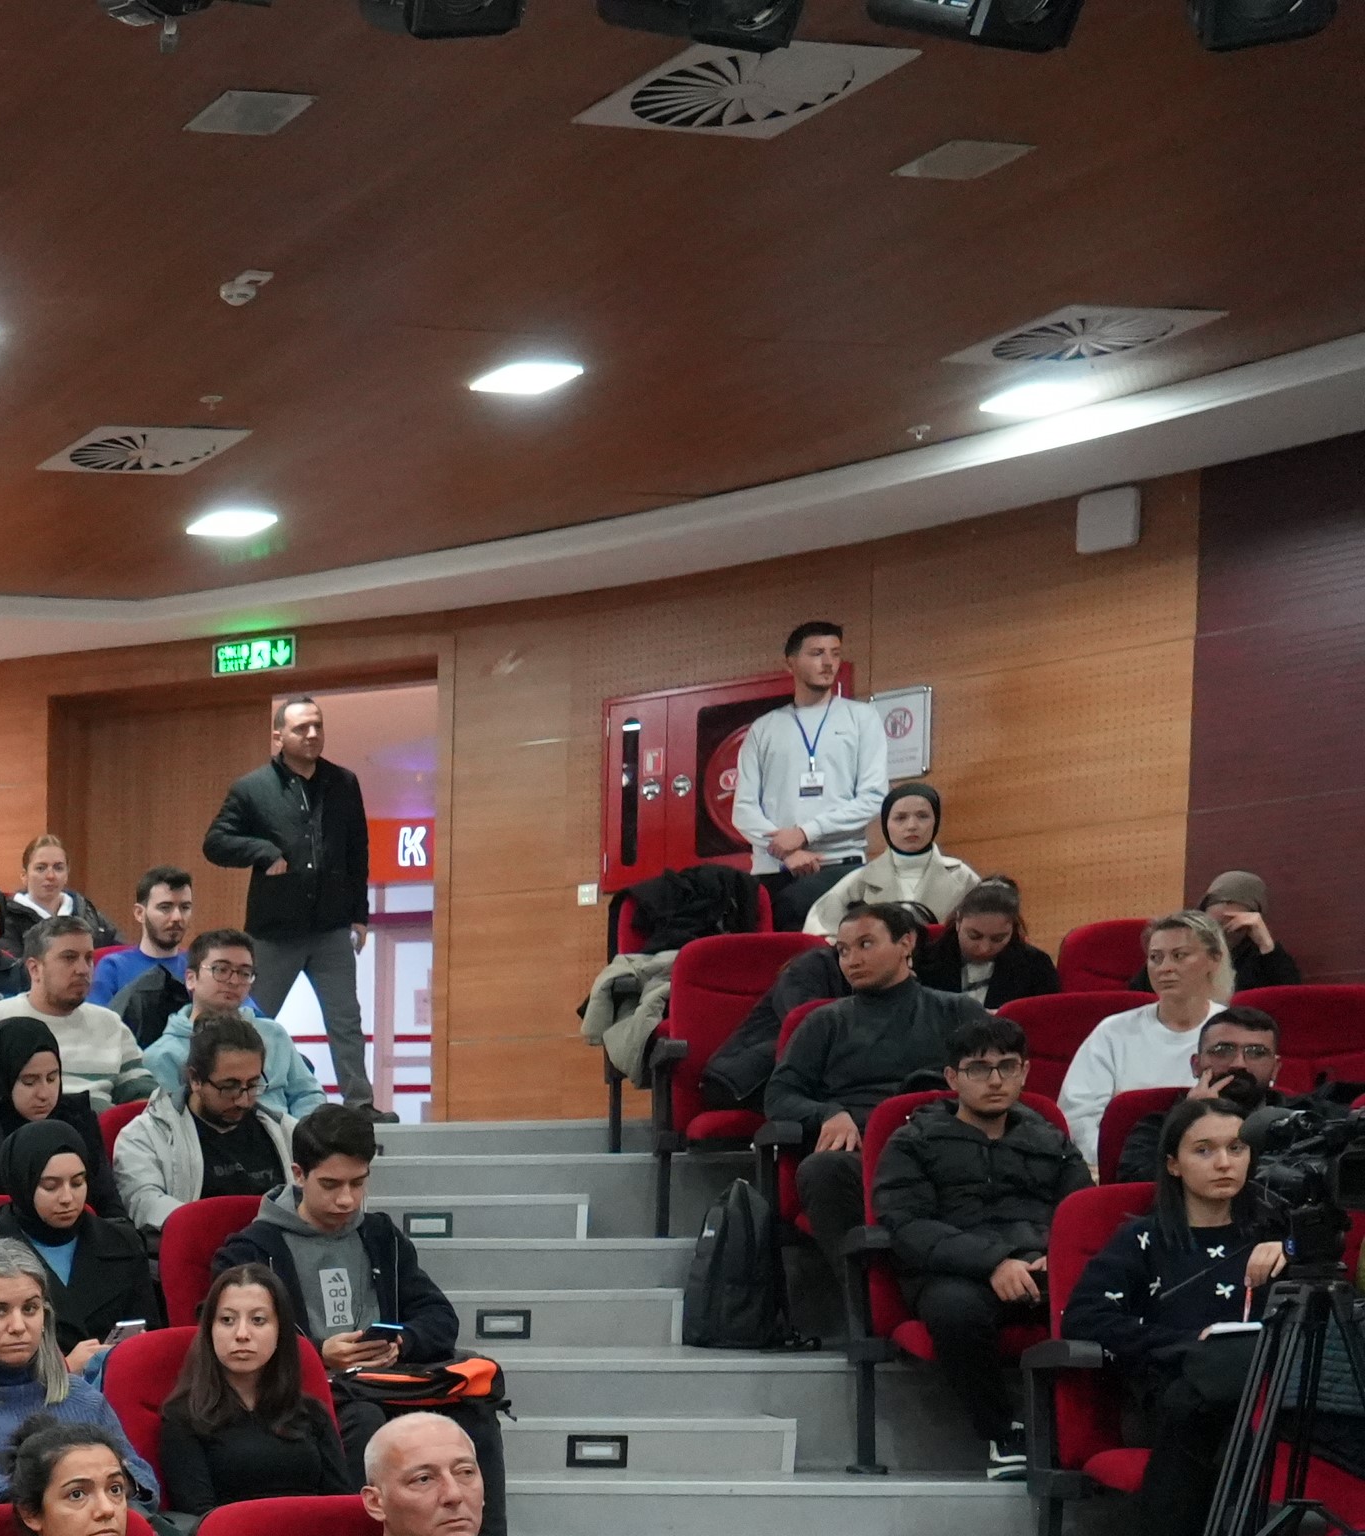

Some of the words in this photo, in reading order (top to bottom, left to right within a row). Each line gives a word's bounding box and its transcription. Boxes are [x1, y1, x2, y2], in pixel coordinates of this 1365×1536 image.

[219, 659, 247, 673] EXIT
[329, 1285, 347, 1297] ad
[332, 1314, 348, 1324] as
